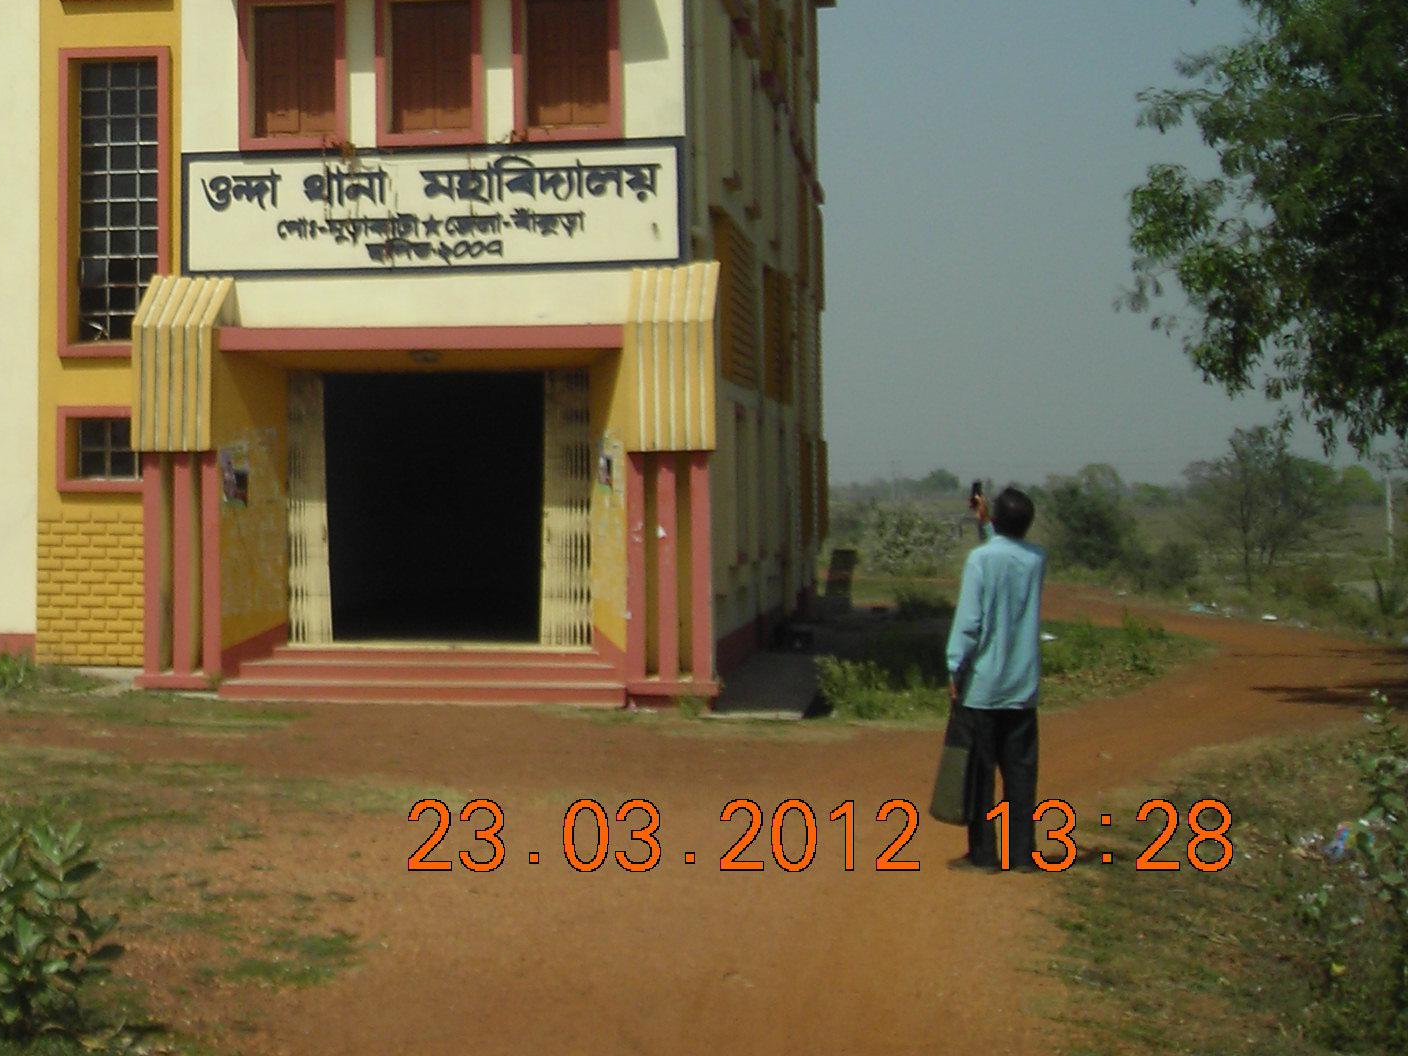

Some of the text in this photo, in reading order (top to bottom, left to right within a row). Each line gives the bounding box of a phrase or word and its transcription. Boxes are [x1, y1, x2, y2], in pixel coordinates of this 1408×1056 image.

[200, 154, 662, 212] ওন্দা থানা মহাবিদ্যালয়
